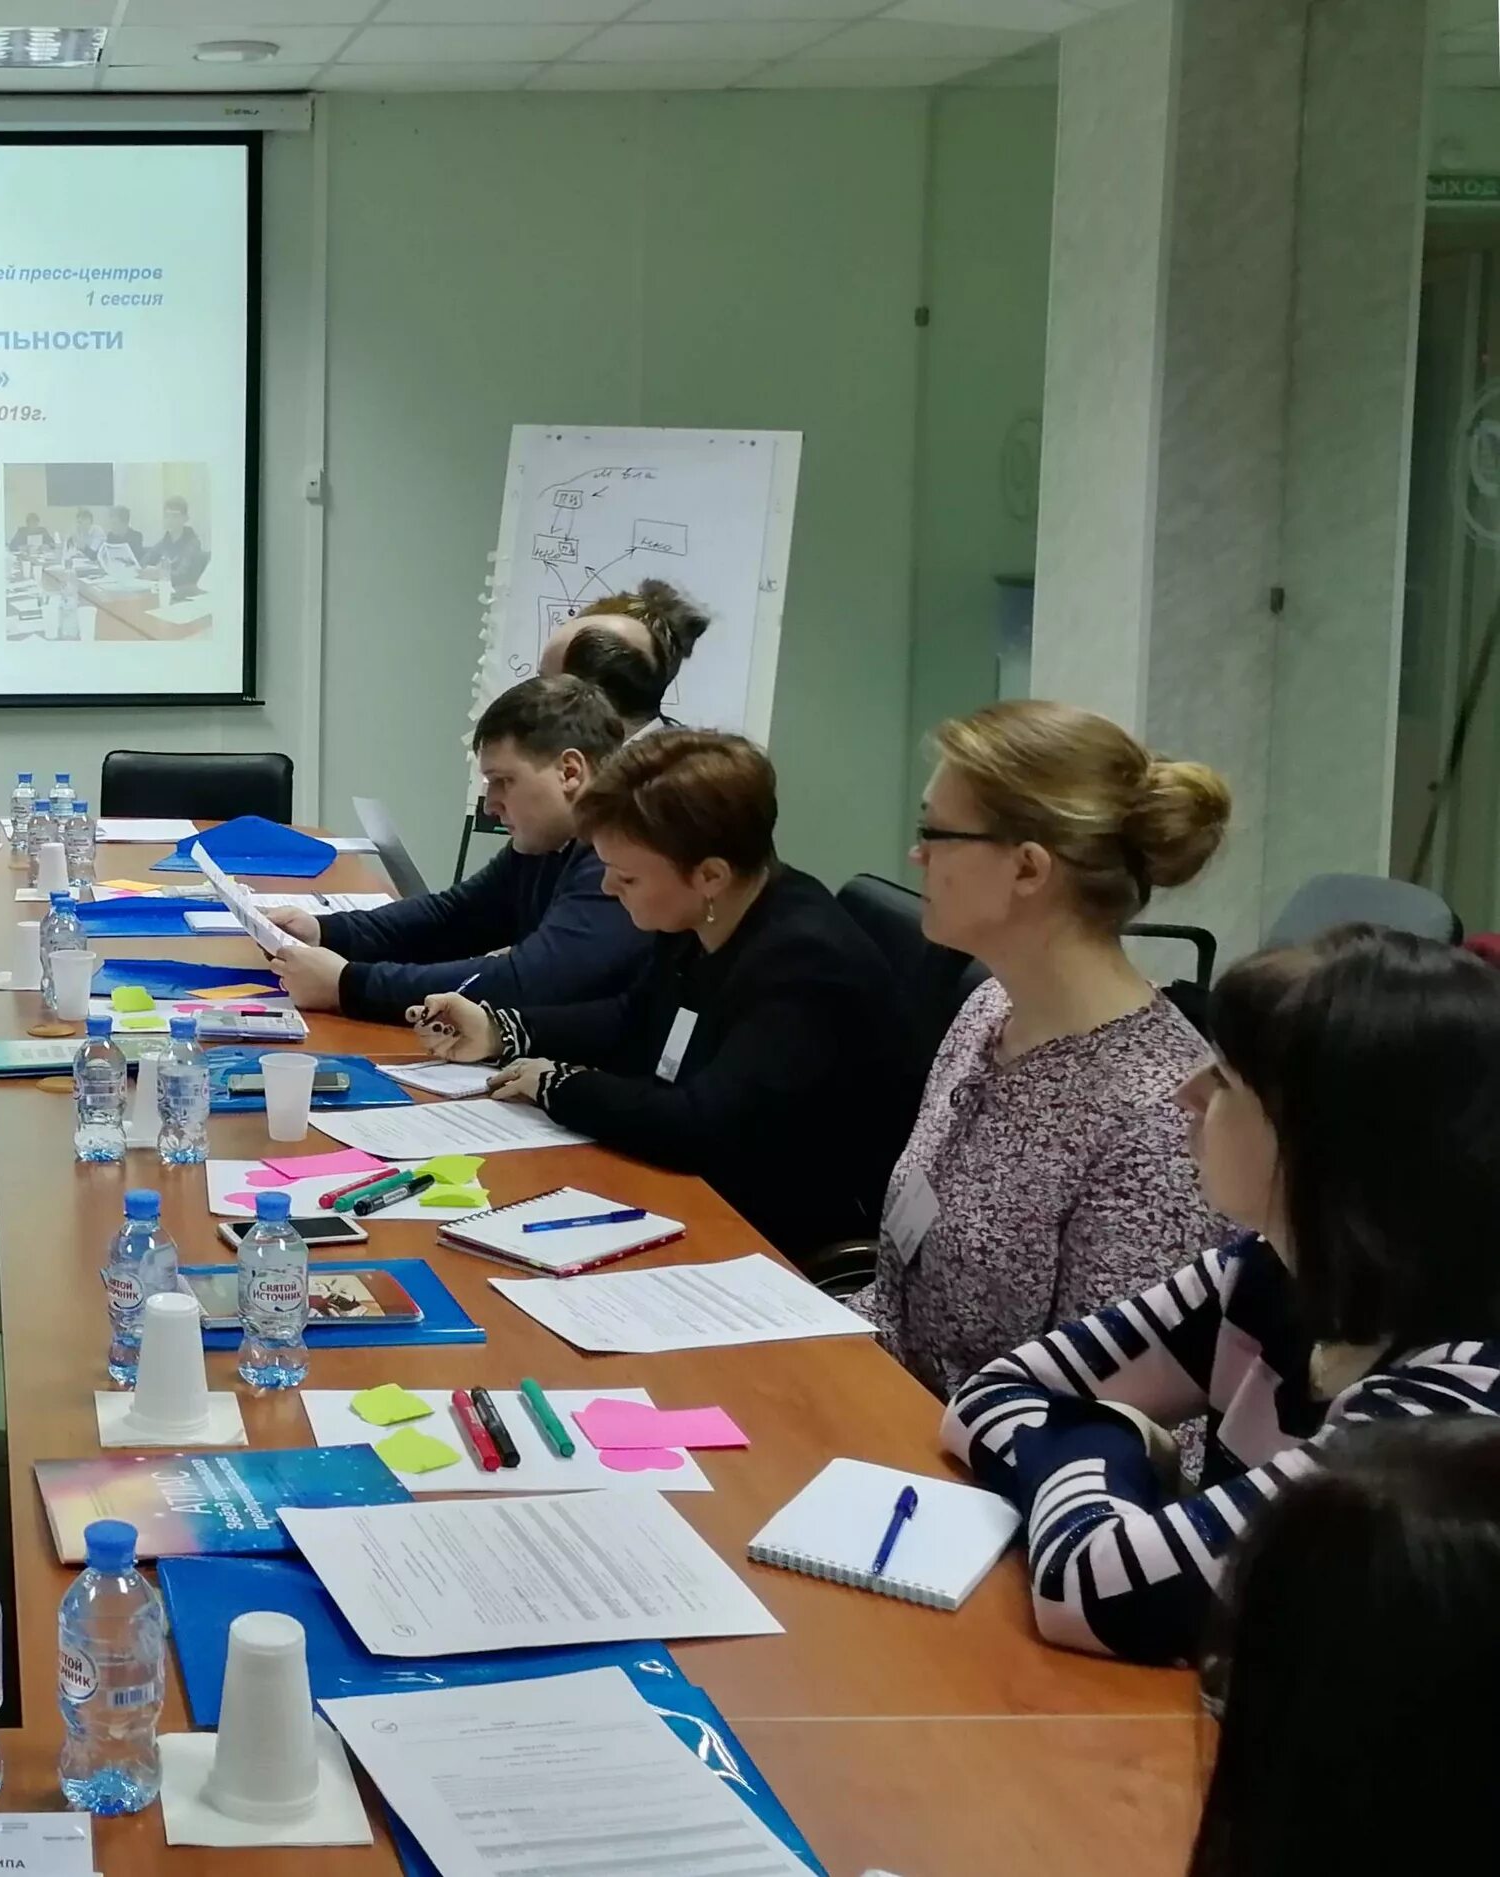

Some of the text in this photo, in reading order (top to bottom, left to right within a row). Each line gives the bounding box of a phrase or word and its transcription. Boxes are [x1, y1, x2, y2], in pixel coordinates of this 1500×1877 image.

[18, 266, 164, 284] пресс-центров
[86, 291, 164, 306] 1 сессия
